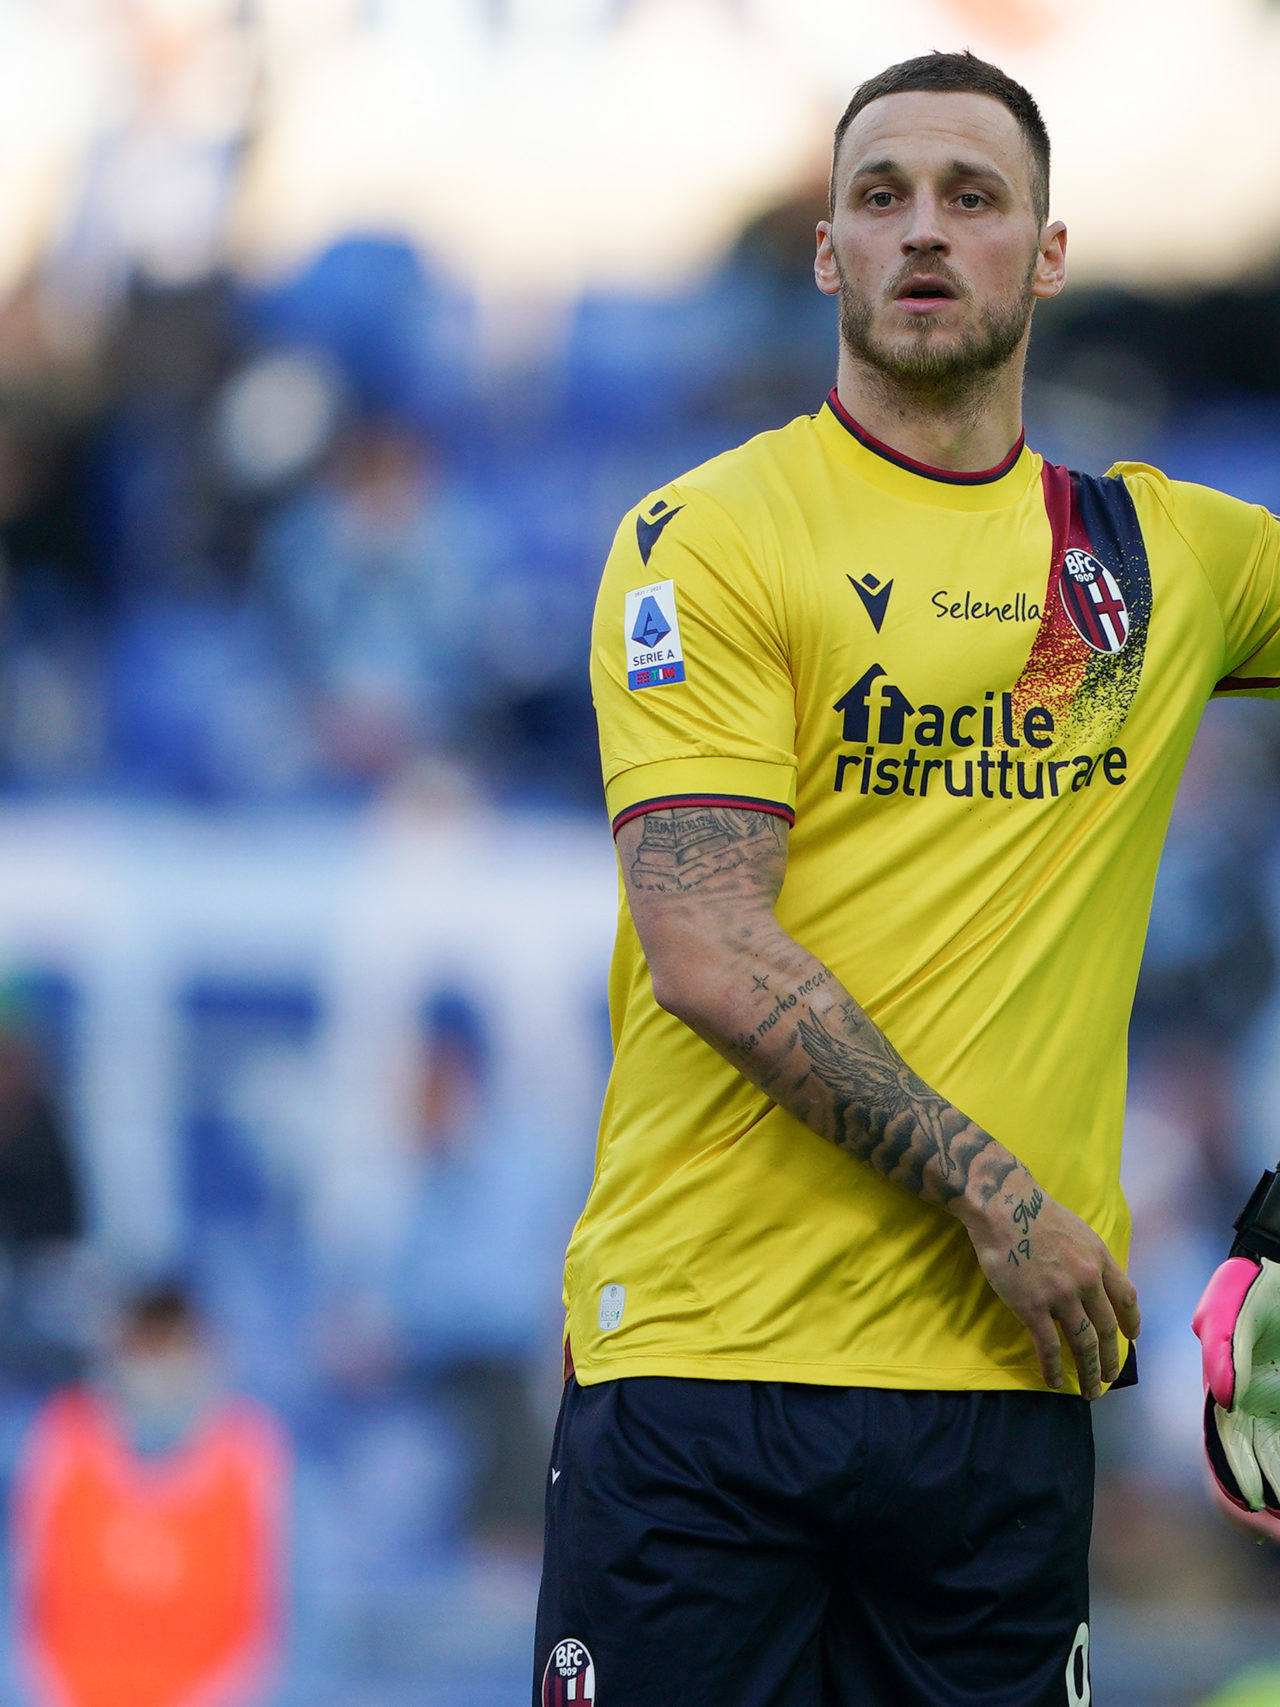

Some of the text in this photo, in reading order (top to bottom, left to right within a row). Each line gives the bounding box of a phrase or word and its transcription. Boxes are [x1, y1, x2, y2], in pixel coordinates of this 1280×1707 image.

[1065, 552, 1096, 575] BFC
[1074, 572, 1095, 583] 1909
[931, 590, 1043, 623] Selenella
[633, 649, 675, 667] SERIE A
[650, 666, 676, 681] TIM
[862, 674, 1055, 749] facile
[834, 746, 1127, 800] ristrutturare
[756, 992, 798, 1038] marko
[1007, 1239, 1030, 1268] 19
[555, 1643, 583, 1668] BFC
[559, 1666, 578, 1677] 1909
